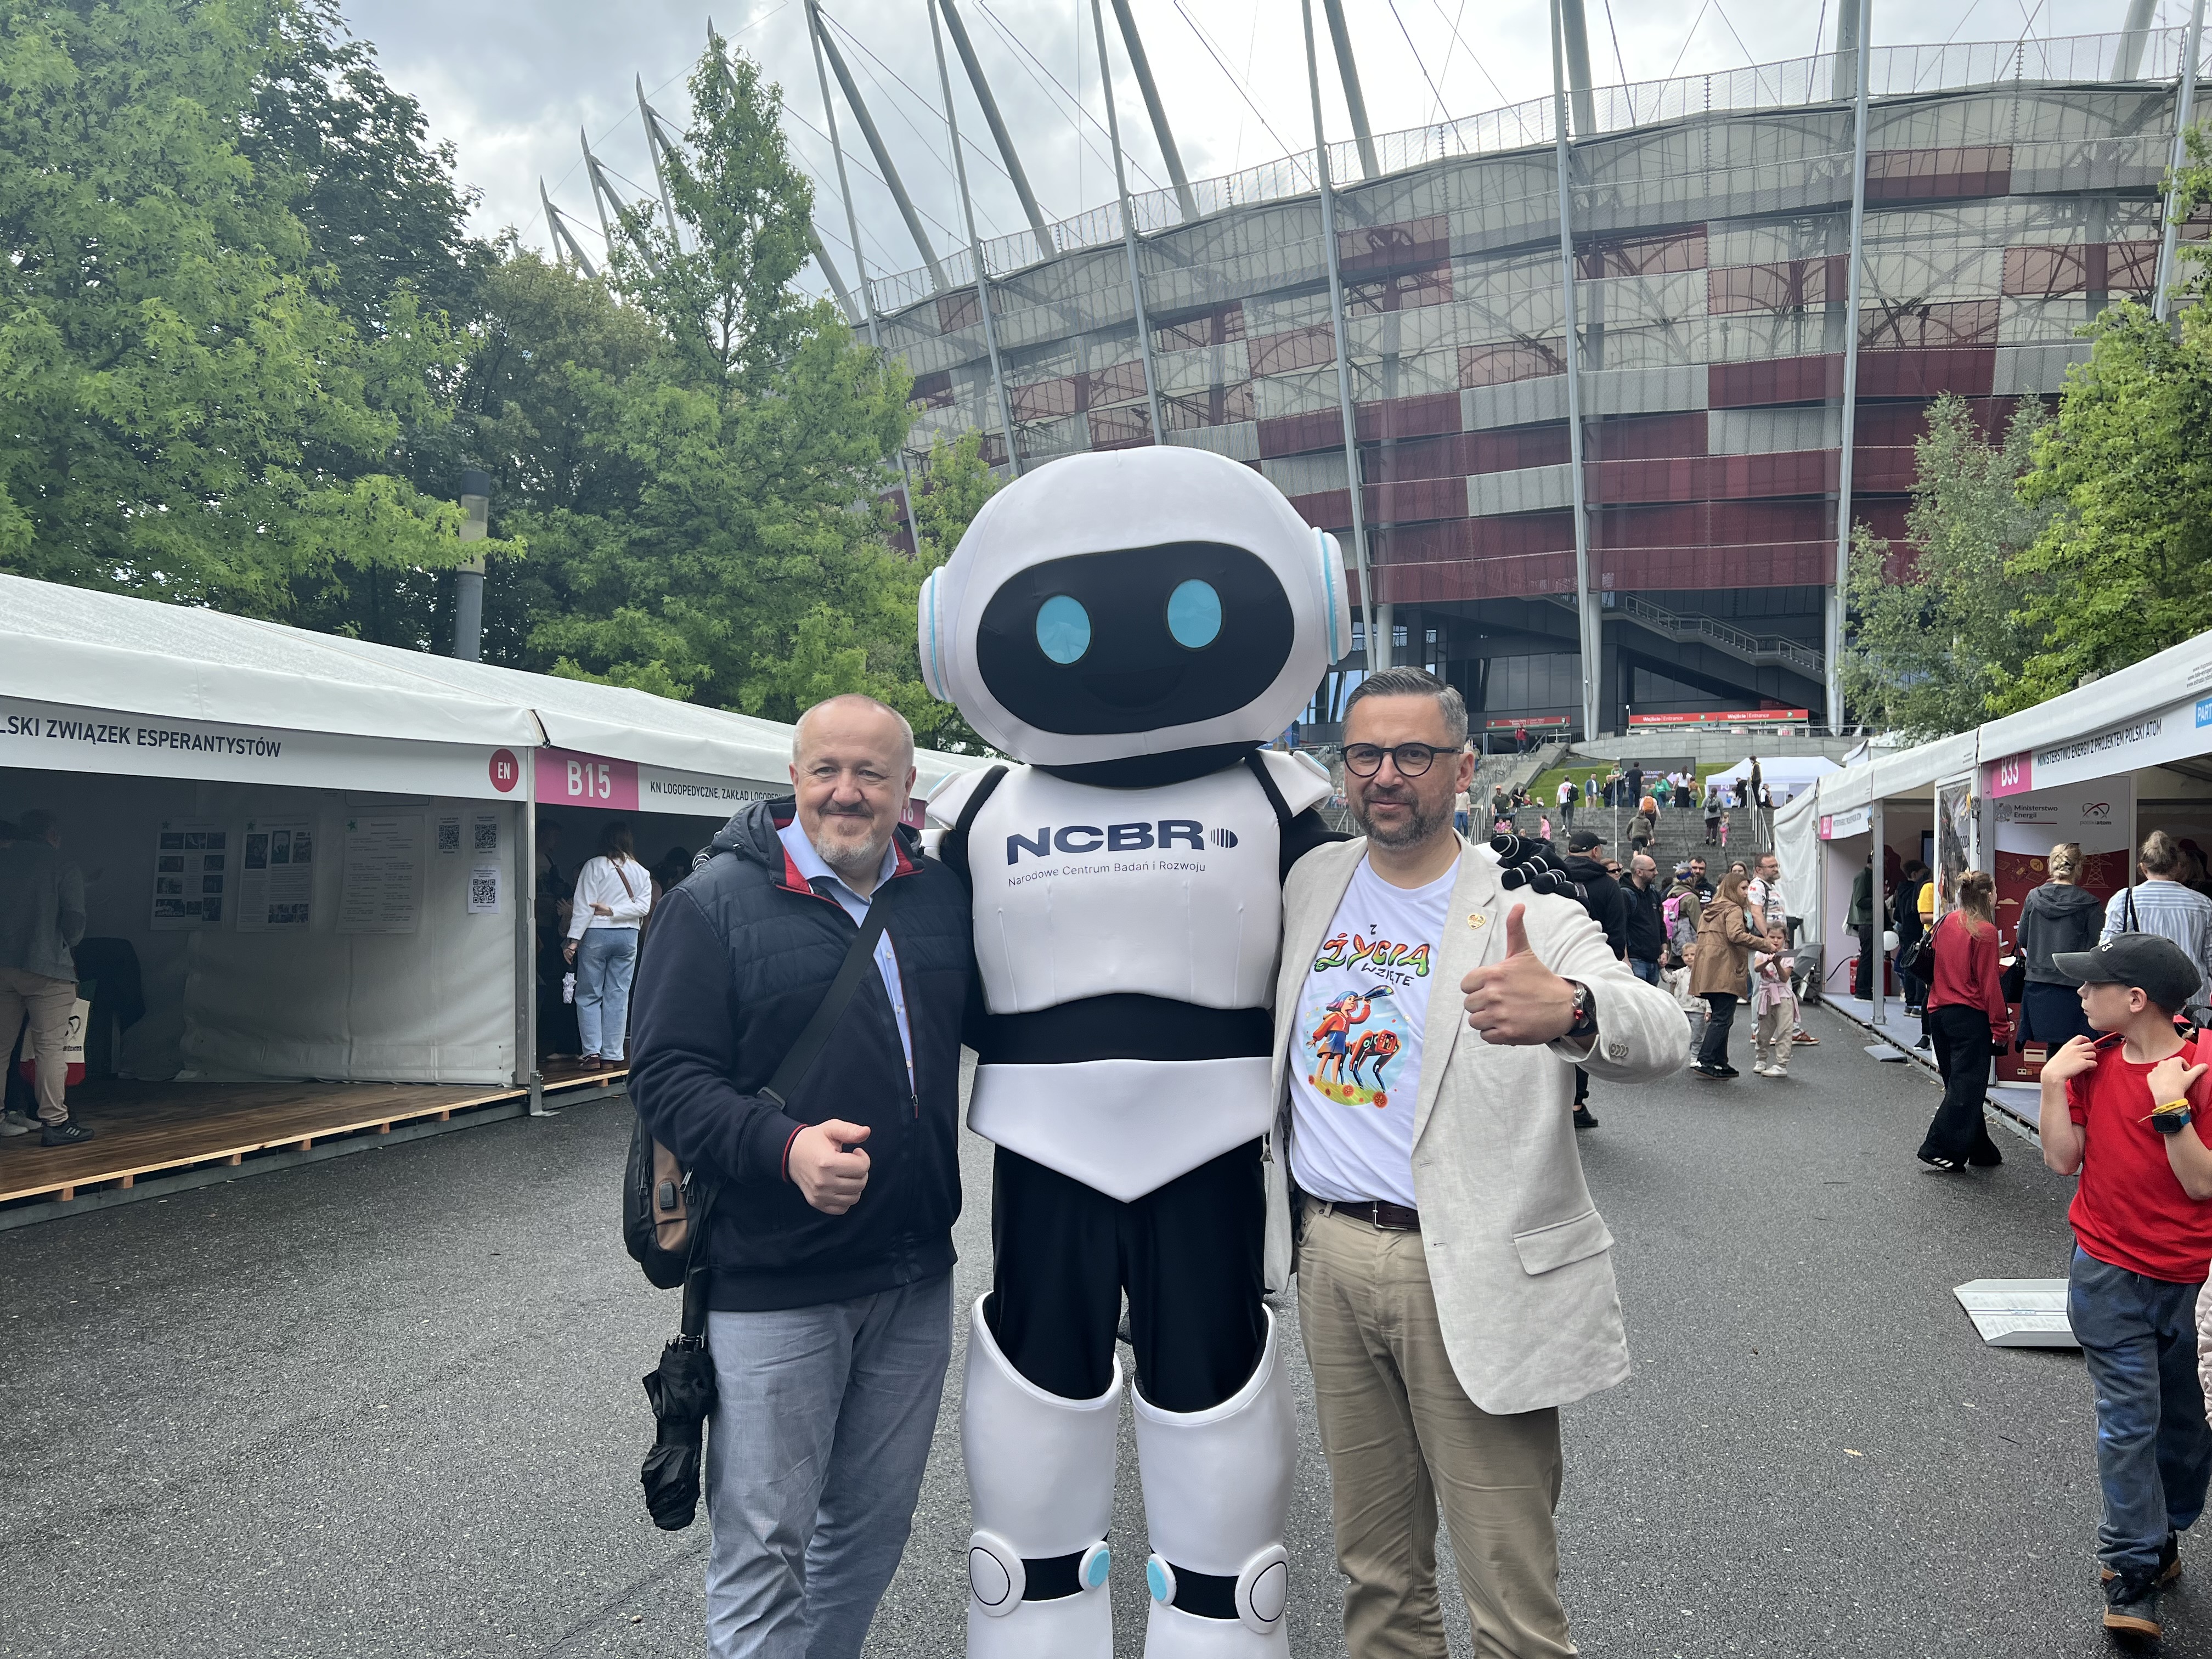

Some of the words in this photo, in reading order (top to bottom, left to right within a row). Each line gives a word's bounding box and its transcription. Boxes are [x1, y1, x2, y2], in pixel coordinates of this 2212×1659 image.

[46, 719, 131, 745] ZWIĄZEK
[137, 728, 281, 758] ESPERANTYSTÓW
[2037, 745, 2070, 767] MINISTERSTWO
[2071, 741, 2090, 759] ENERGII
[2090, 738, 2094, 753] Z
[2095, 729, 2124, 753] PROJEKTEM
[2125, 723, 2145, 744] POLSKI
[2146, 718, 2162, 738] ATOM
[498, 761, 510, 780] EN
[567, 760, 611, 799] B15
[2001, 754, 2019, 787] B33
[650, 781, 661, 793] KN
[663, 782, 720, 800] LOGOPEDYCZNE,
[722, 788, 749, 801] ZAKŁAD
[1007, 820, 1205, 866] NCBR
[1008, 867, 1059, 887] Narodowe
[1062, 865, 1110, 876] Centrum
[1114, 861, 1149, 872] Badań
[1153, 861, 1156, 871] i
[1159, 861, 1206, 872] Rozwoju
[1313, 933, 1430, 978] ŻYCIA
[1361, 962, 1414, 987] WZIĘTE
